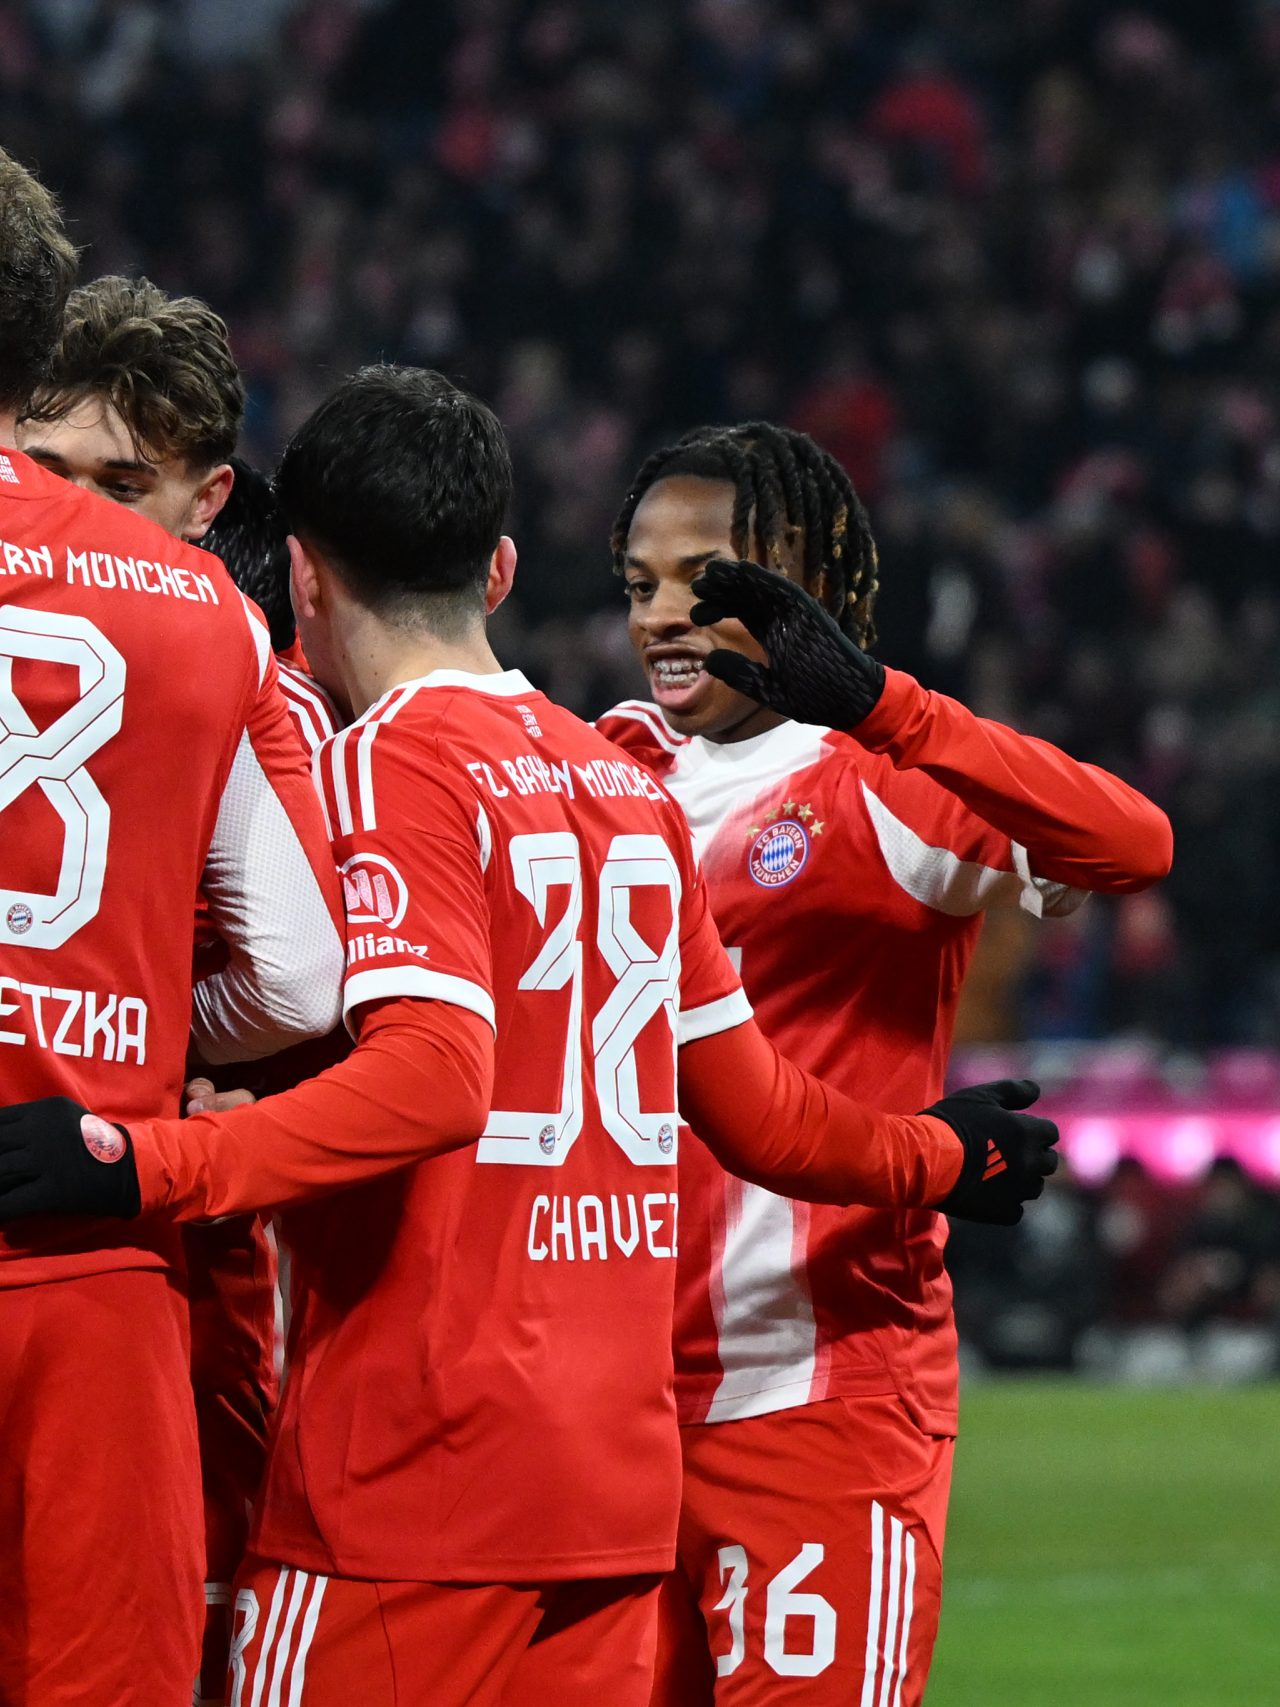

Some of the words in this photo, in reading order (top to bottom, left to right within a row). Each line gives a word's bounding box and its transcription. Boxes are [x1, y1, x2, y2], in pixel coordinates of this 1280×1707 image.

[66, 546, 220, 606] MÜNCHEN
[756, 834, 769, 848] FC
[772, 825, 803, 848] BAYERN
[346, 933, 430, 965] llianz
[476, 832, 680, 1167] 38
[713, 1543, 837, 1677] 36
